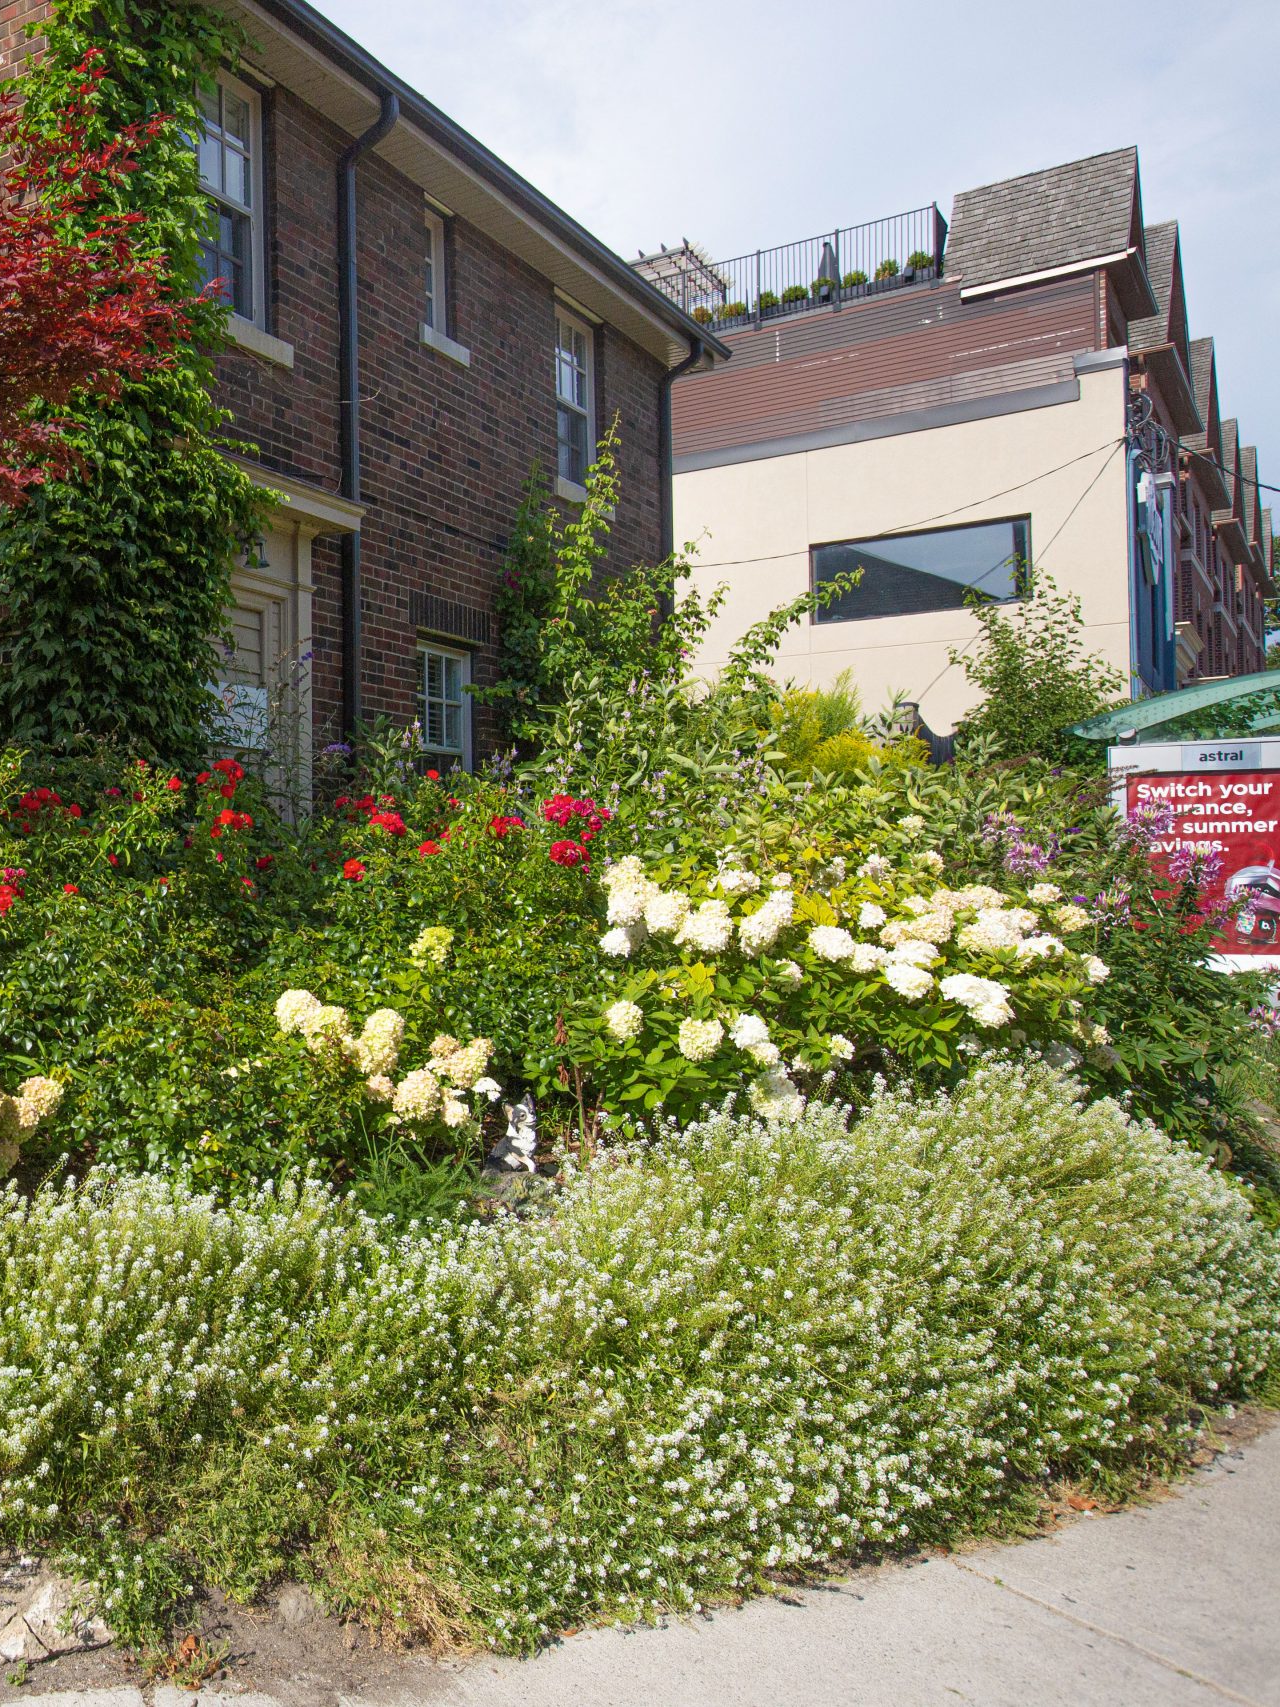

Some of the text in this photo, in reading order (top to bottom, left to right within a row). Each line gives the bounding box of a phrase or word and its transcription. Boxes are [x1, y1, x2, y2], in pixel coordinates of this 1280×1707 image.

[1199, 750, 1243, 762] astral
[1137, 782, 1273, 798] Switch your
[1183, 820, 1278, 834] summer
[1150, 838, 1230, 854] avings.
